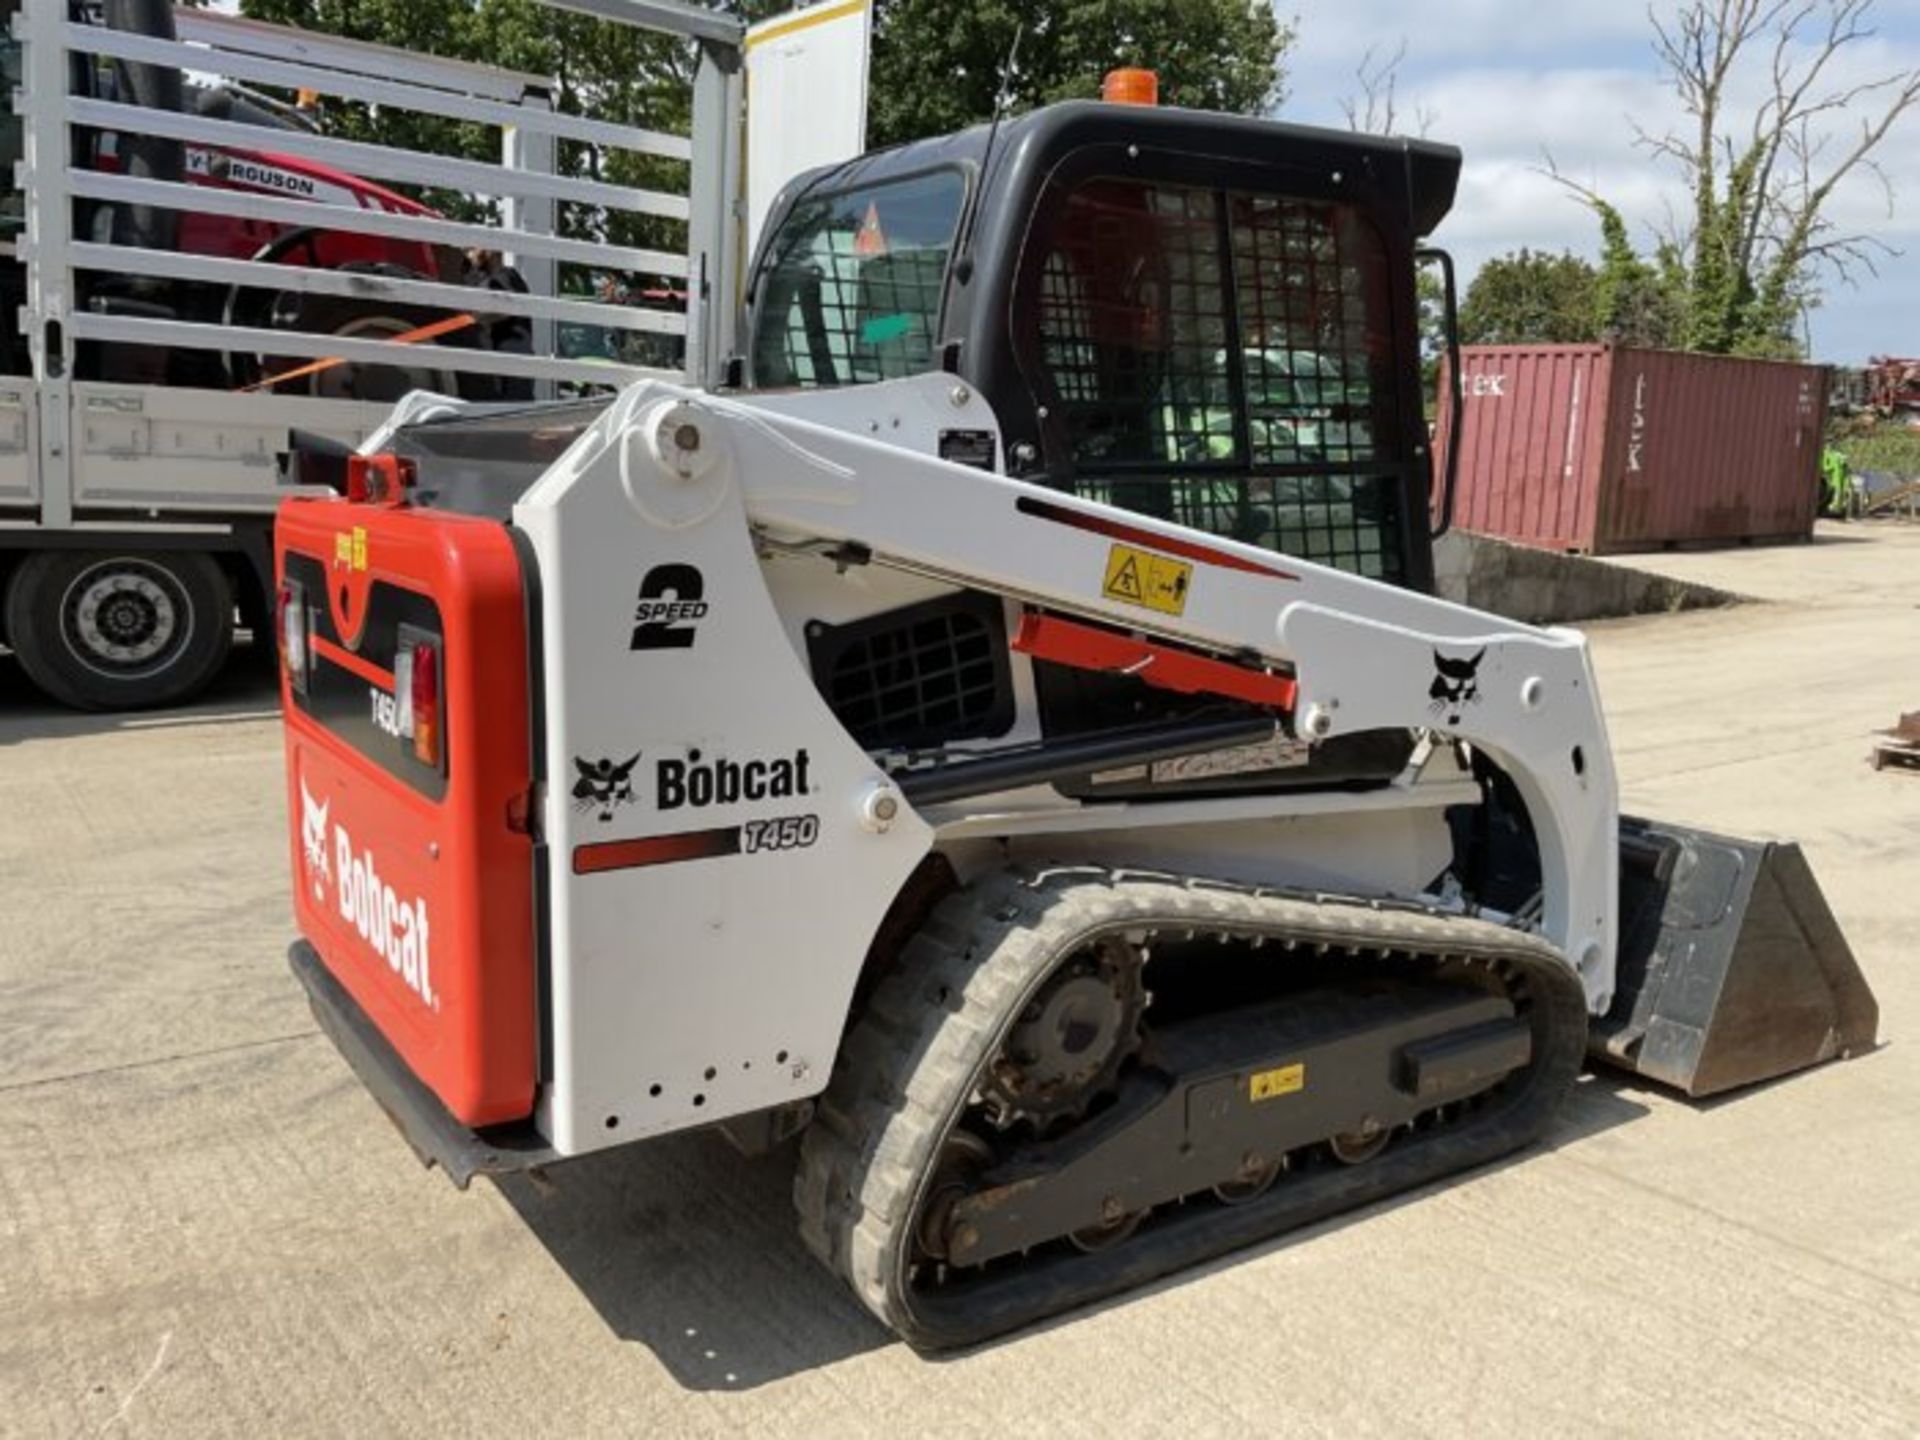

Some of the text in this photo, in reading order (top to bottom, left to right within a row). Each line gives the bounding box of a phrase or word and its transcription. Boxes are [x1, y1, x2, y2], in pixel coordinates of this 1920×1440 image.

[630, 562, 704, 651] 2
[635, 602, 709, 621] SPEED
[657, 748, 809, 811] Bobcat
[745, 814, 820, 853] T450
[334, 823, 432, 1007] Bobcat
